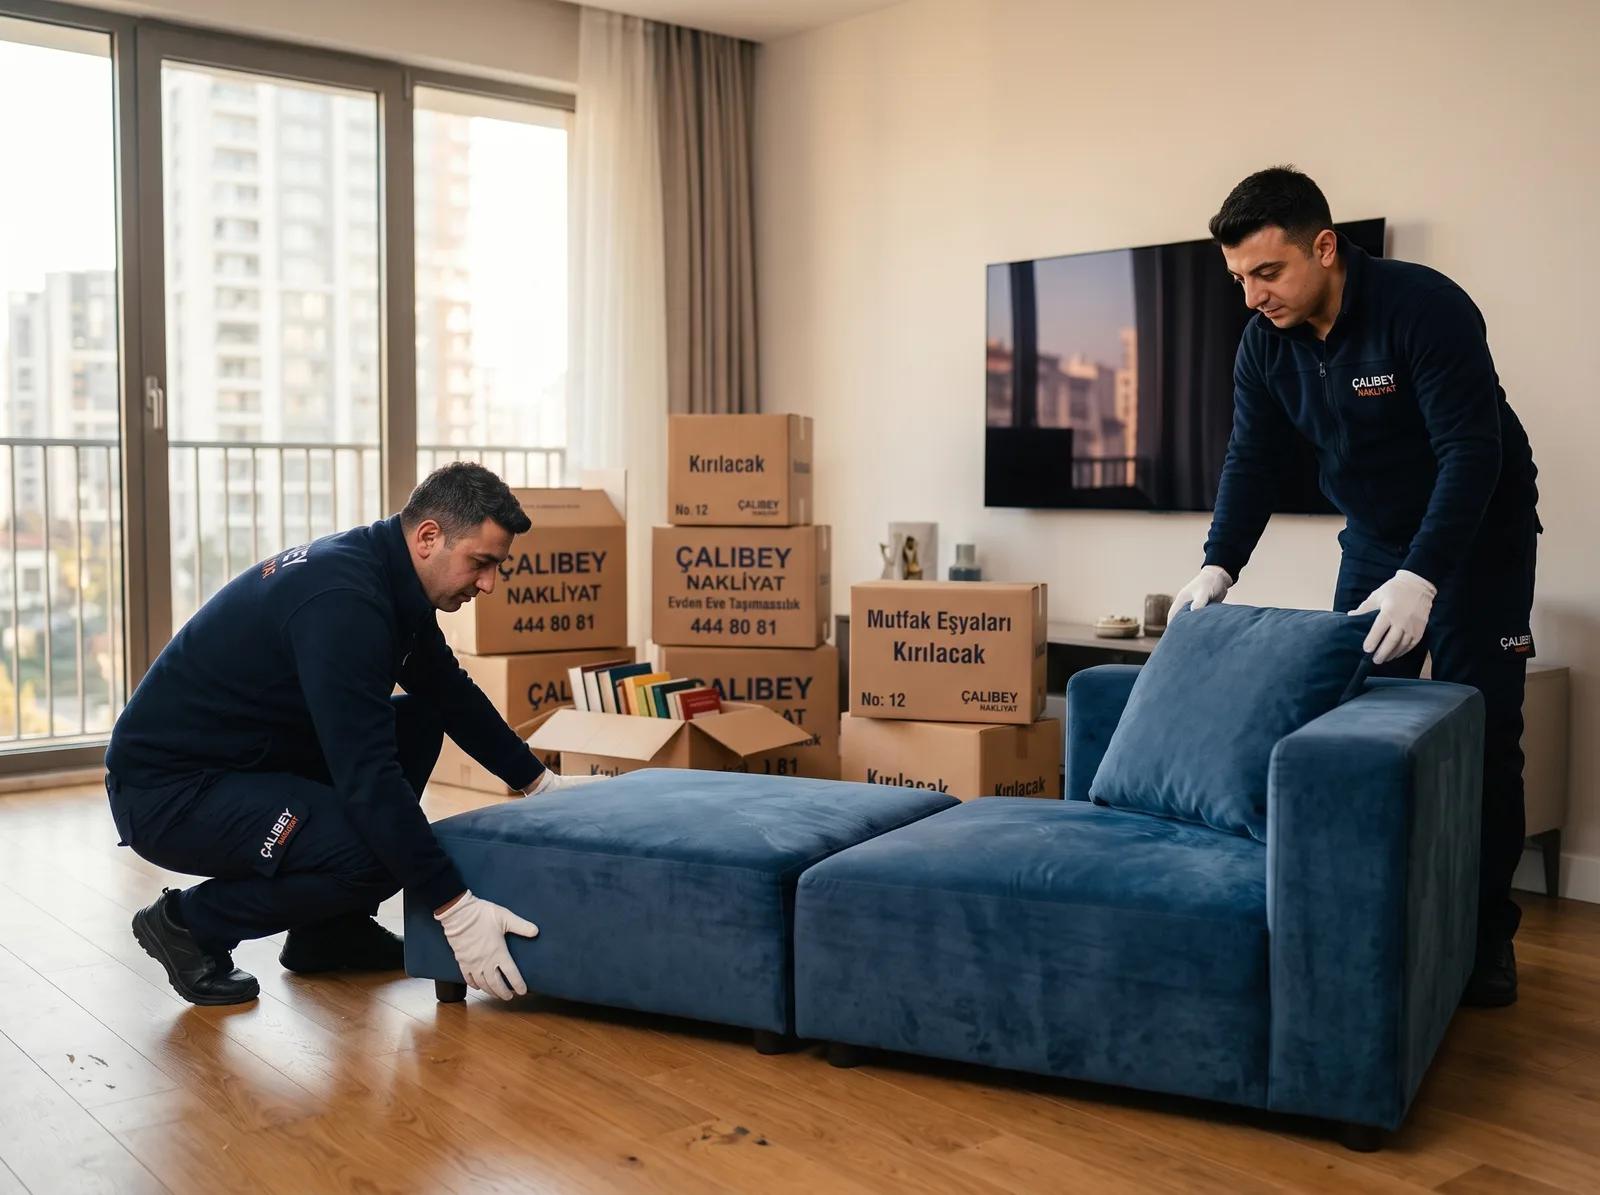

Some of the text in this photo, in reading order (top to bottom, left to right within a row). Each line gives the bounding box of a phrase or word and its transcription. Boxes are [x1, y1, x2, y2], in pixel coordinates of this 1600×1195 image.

[1352, 374, 1394, 390] ÇALIBEY
[689, 455, 765, 473] Kırılacak
[696, 504, 708, 516] 12
[498, 551, 607, 582] ÇALIBEY
[676, 546, 792, 573] ÇALIBEY
[687, 572, 785, 591] NAKLİYAT
[507, 581, 602, 605] NAKLİYAT
[706, 596, 725, 609] Eve
[513, 613, 595, 633] 444 80 81
[691, 618, 776, 636] 444 80 81
[867, 609, 1012, 635] Mutfak Eşyaları
[893, 641, 985, 665] Kırılacak
[528, 680, 573, 710] ÇAL
[861, 691, 906, 708] No: 12
[961, 690, 1018, 705] ÇALIBEY
[260, 807, 293, 859] ÇALIBEY
